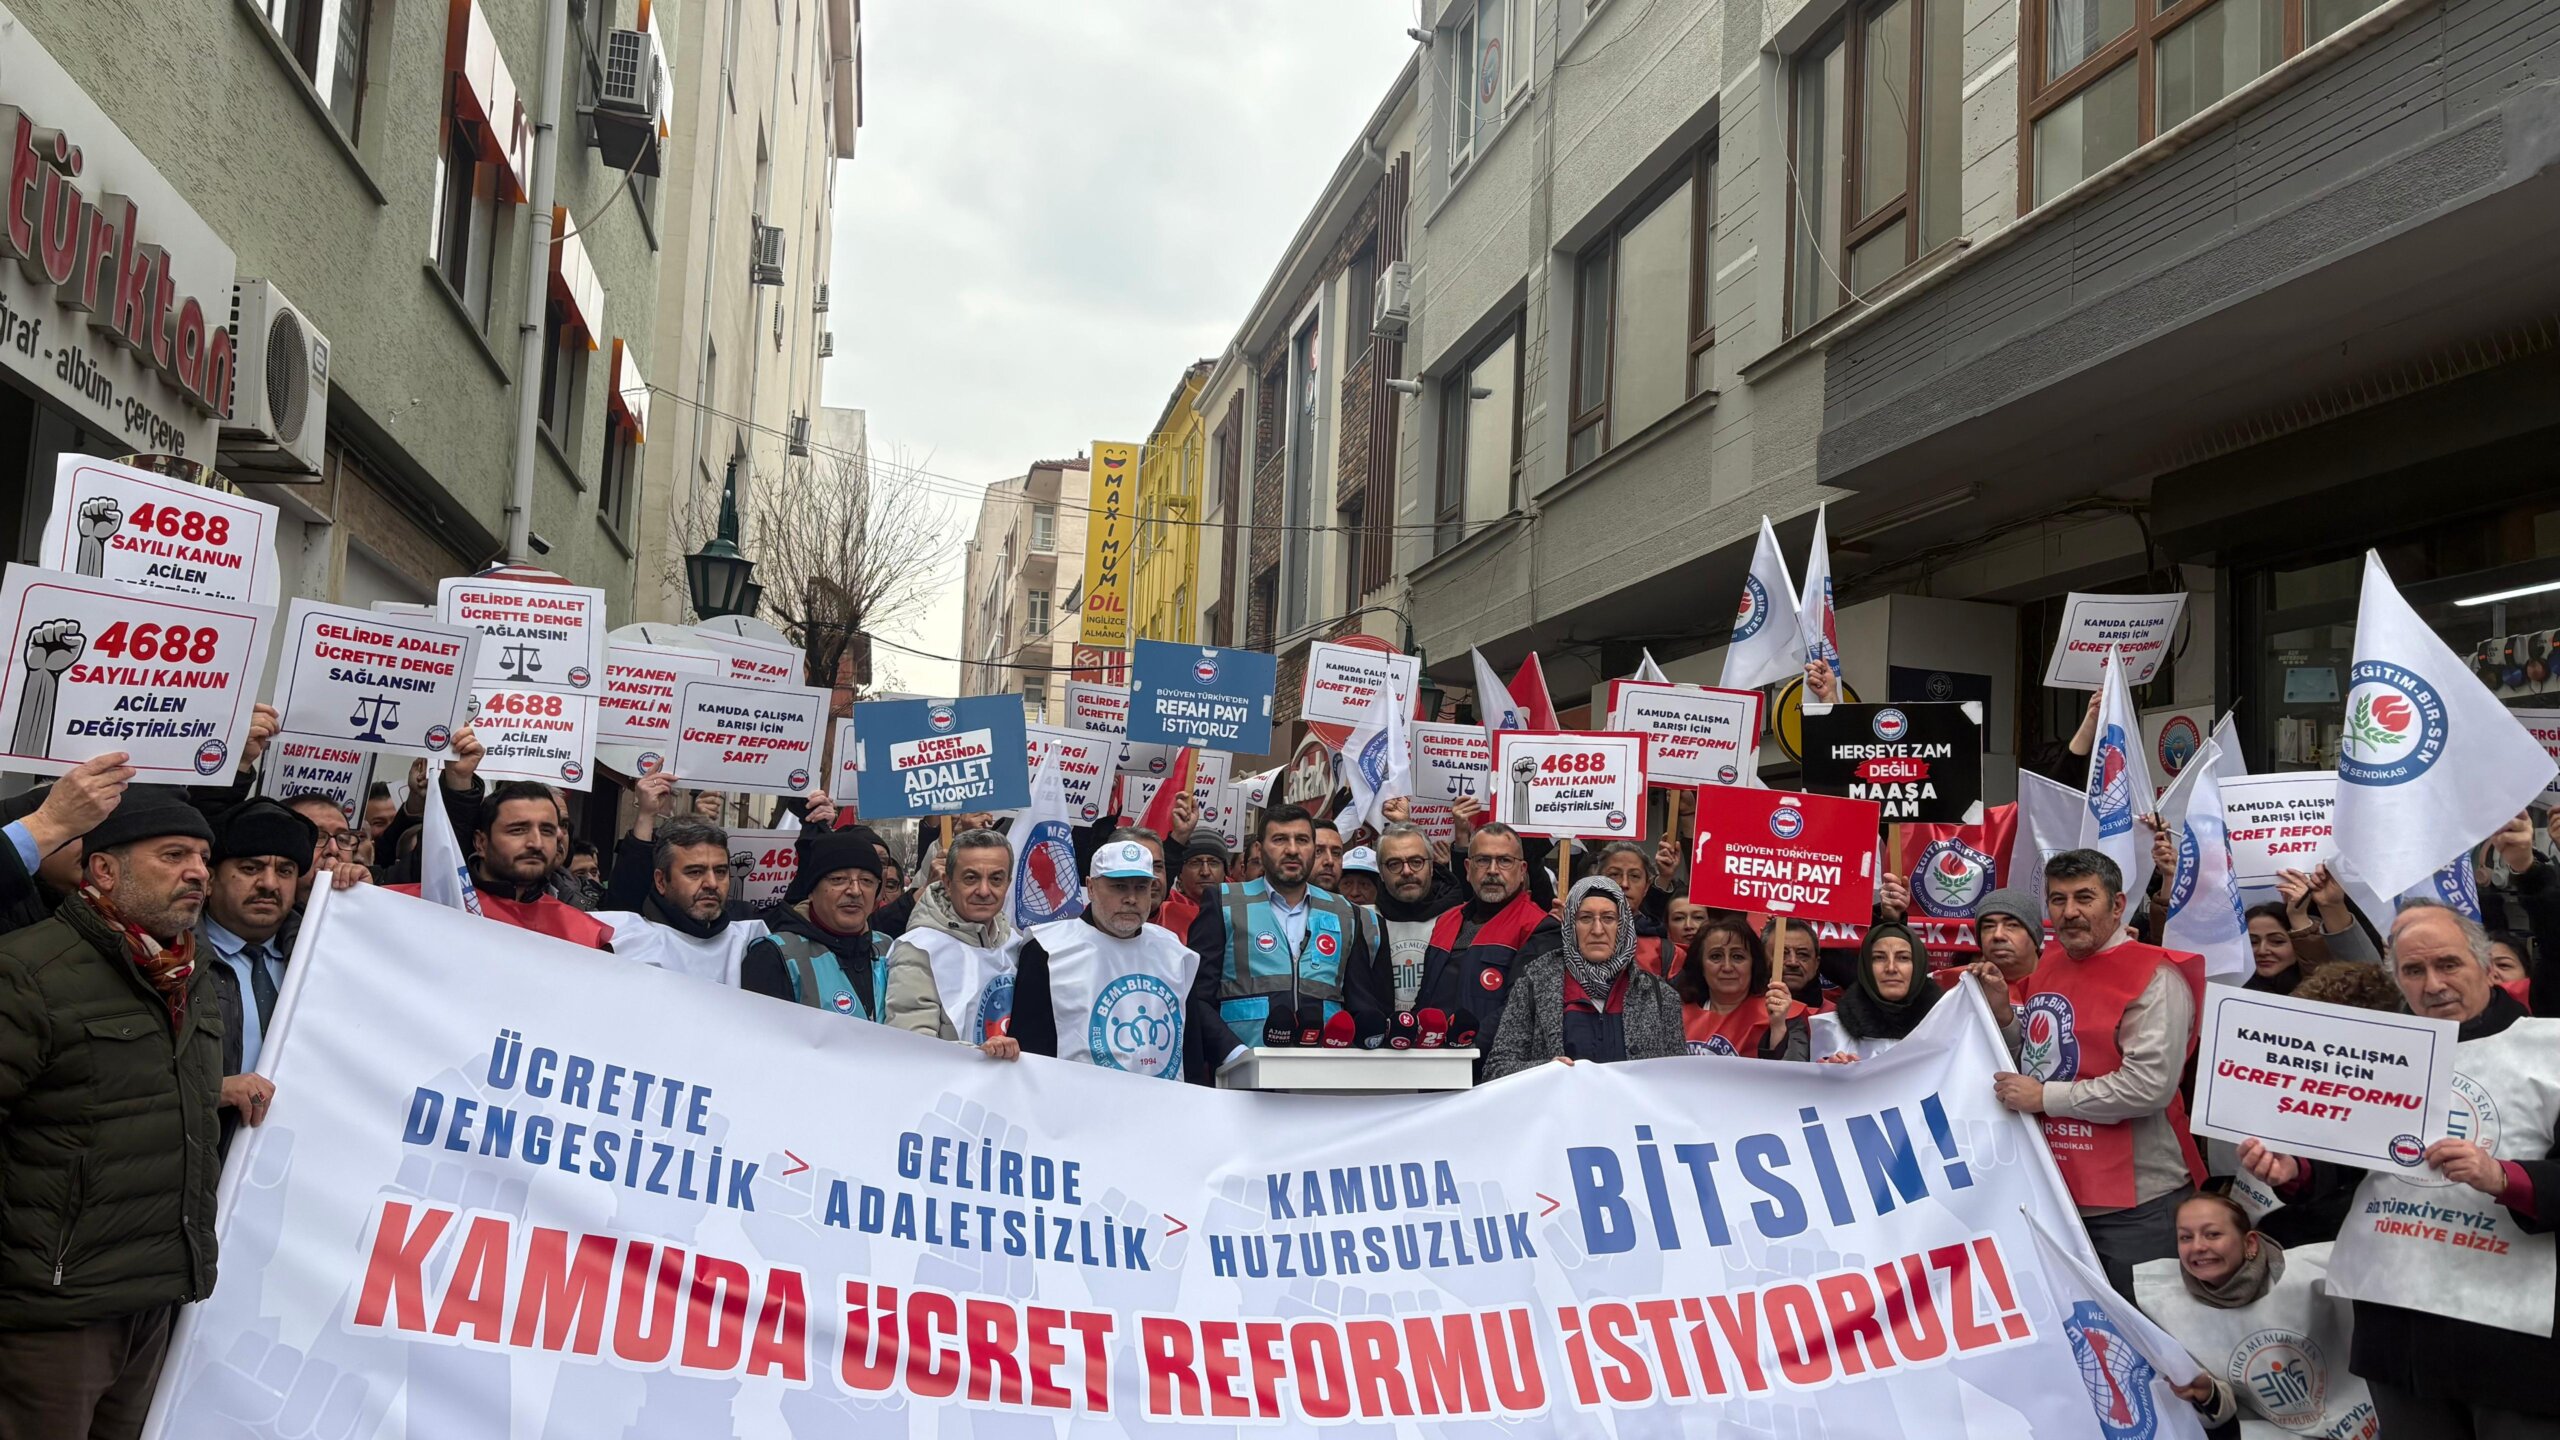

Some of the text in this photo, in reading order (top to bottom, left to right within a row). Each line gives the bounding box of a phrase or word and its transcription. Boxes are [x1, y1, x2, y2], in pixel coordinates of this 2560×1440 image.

[6, 110, 234, 422] türktan
[57, 345, 185, 457] albüm çerçeve
[128, 502, 230, 546] 4688
[1099, 474, 1123, 587] MAXIMUM
[111, 534, 243, 570] SAYILI KANUN
[146, 563, 207, 584] ACİLEN
[460, 592, 585, 612] GELİRDE ADALET
[1088, 592, 1125, 612] DİL
[461, 606, 583, 627] ÜCRETTE DENGE
[1086, 614, 1126, 626] İNGİLİZCE
[2084, 618, 2164, 628] KAMUDA ÇALIŞMA
[93, 620, 219, 664] 4688
[316, 623, 461, 657] GELİRDE ADALET
[1084, 628, 1126, 639] ALMANCA
[2098, 630, 2150, 639] BARIŞI İÇİN
[2068, 640, 2111, 652] ÜCRET
[314, 643, 455, 677] ÜCRETTE DENGE
[759, 661, 788, 677] ZAM
[1326, 662, 1362, 675] KAMUDA
[2100, 656, 2136, 668] ŞT!
[68, 664, 230, 689] SAYILI KANUN
[328, 667, 436, 694] SAĞLANSIN!
[605, 664, 677, 682] EYYANEN
[1338, 673, 1366, 684] BARIŞI
[608, 680, 673, 698] YANSITIL
[1316, 679, 1351, 693] ÜCRET
[113, 693, 187, 713] ACİLEN
[485, 692, 563, 717] 4688
[599, 696, 656, 712] EMEKLİ
[1077, 694, 1120, 708] GELİRDE
[1156, 688, 1249, 705] BÜYÜYEN TÜRKİYE'DEN
[1342, 696, 1371, 708] ŞART
[698, 703, 804, 723] KAMUDA ÇALIŞMA
[1077, 706, 1124, 721] ÜCRETTE
[1155, 698, 1248, 723] REFAH PAYI
[1637, 708, 1730, 725] KAMUDA ÇALIŞMA
[2351, 664, 2442, 764] EĞİTİM-BİR-SEN
[66, 716, 216, 741] DEĞİŞTİRİLSİN!
[473, 717, 574, 731] SAYILI KANUN
[625, 715, 670, 730] ALSIN
[717, 719, 783, 734] BARIŞI İÇİN
[1085, 721, 1126, 735] SAĞLAN
[1653, 721, 1711, 734] BARIŞI İÇİN
[501, 732, 548, 744] ACİLEN
[683, 727, 810, 752] ÜCRET REFORMU
[1423, 735, 1488, 747] GELİRDE ADA
[1670, 735, 1737, 751] REFORMU
[2530, 726, 2560, 741] ERGİ
[486, 745, 571, 760] EĞİŞTİRİLSİN!
[917, 736, 962, 754] ÜCRET
[1423, 747, 1490, 759] ÜCRETTE DEN
[1658, 747, 1698, 760] ŞART!
[1831, 743, 1951, 763] HERŞEYE ZAM
[722, 749, 768, 765] ŞART!
[898, 743, 986, 768] SKALASINDA
[1431, 759, 1489, 771] SAĞLANSIN
[1541, 752, 1606, 773] 4688
[282, 764, 353, 784] YA MATRAH
[904, 757, 992, 794] ADALET
[1869, 761, 1918, 777] DEĞİL!
[2350, 766, 2407, 779] SENDİKASI
[1532, 774, 1616, 787] SAYILI KANUN
[1555, 788, 1594, 799] ACİLEN
[1848, 782, 1938, 802] MAAŞA
[1535, 799, 1614, 813] DEĞİŞTİRİLSİN!
[1883, 801, 1919, 817] AM
[2227, 798, 2335, 813] KAMUDA ÇALIŞM
[2251, 810, 2325, 824] BARIŞI İÇİN
[2279, 825, 2333, 838] REFOR
[1725, 843, 1843, 863] BÜYÜYEN TÜRKİYE'DEN
[2267, 841, 2317, 856] ŞART!
[748, 870, 788, 882] SAYILI
[1724, 855, 1841, 886] REFAH PAYI
[1096, 975, 1177, 1017] BEM-BİR-SEN
[2237, 1027, 2409, 1067] KAMUDA ÇALIŞMA
[1140, 1057, 1157, 1066] 1994
[2266, 1052, 2374, 1081] BARIŞI İÇİN
[487, 1027, 714, 1136] ÜCRETTE
[2217, 1059, 2423, 1111] ÜCRET REFORMU
[2276, 1095, 2352, 1122] ŞART!
[2451, 1076, 2495, 1123] UR-SEN
[401, 1086, 761, 1212] DENGESİZLİK
[2050, 1141, 2093, 1151] SENDİKASI
[897, 1130, 1084, 1206] GELİRDE
[1565, 1089, 1977, 1256] BİTSİN!
[1266, 1158, 1461, 1221] KAMUDA
[2233, 1178, 2274, 1210] MUR-SEN
[2364, 1197, 2497, 1233] BİZ TÜRKİYE'YİZ
[823, 1179, 1153, 1273] ADALETSİZLİK
[1208, 1210, 1540, 1280] HUZURSUZLUK
[2374, 1218, 2511, 1255] TÜRKİYE BİZİZ
[354, 1201, 808, 1385] KAMUDA
[840, 1279, 1117, 1413] ÜCRET
[1142, 1308, 1547, 1419] REFORMU
[1563, 1235, 2030, 1406] İSTİYORUZ!
